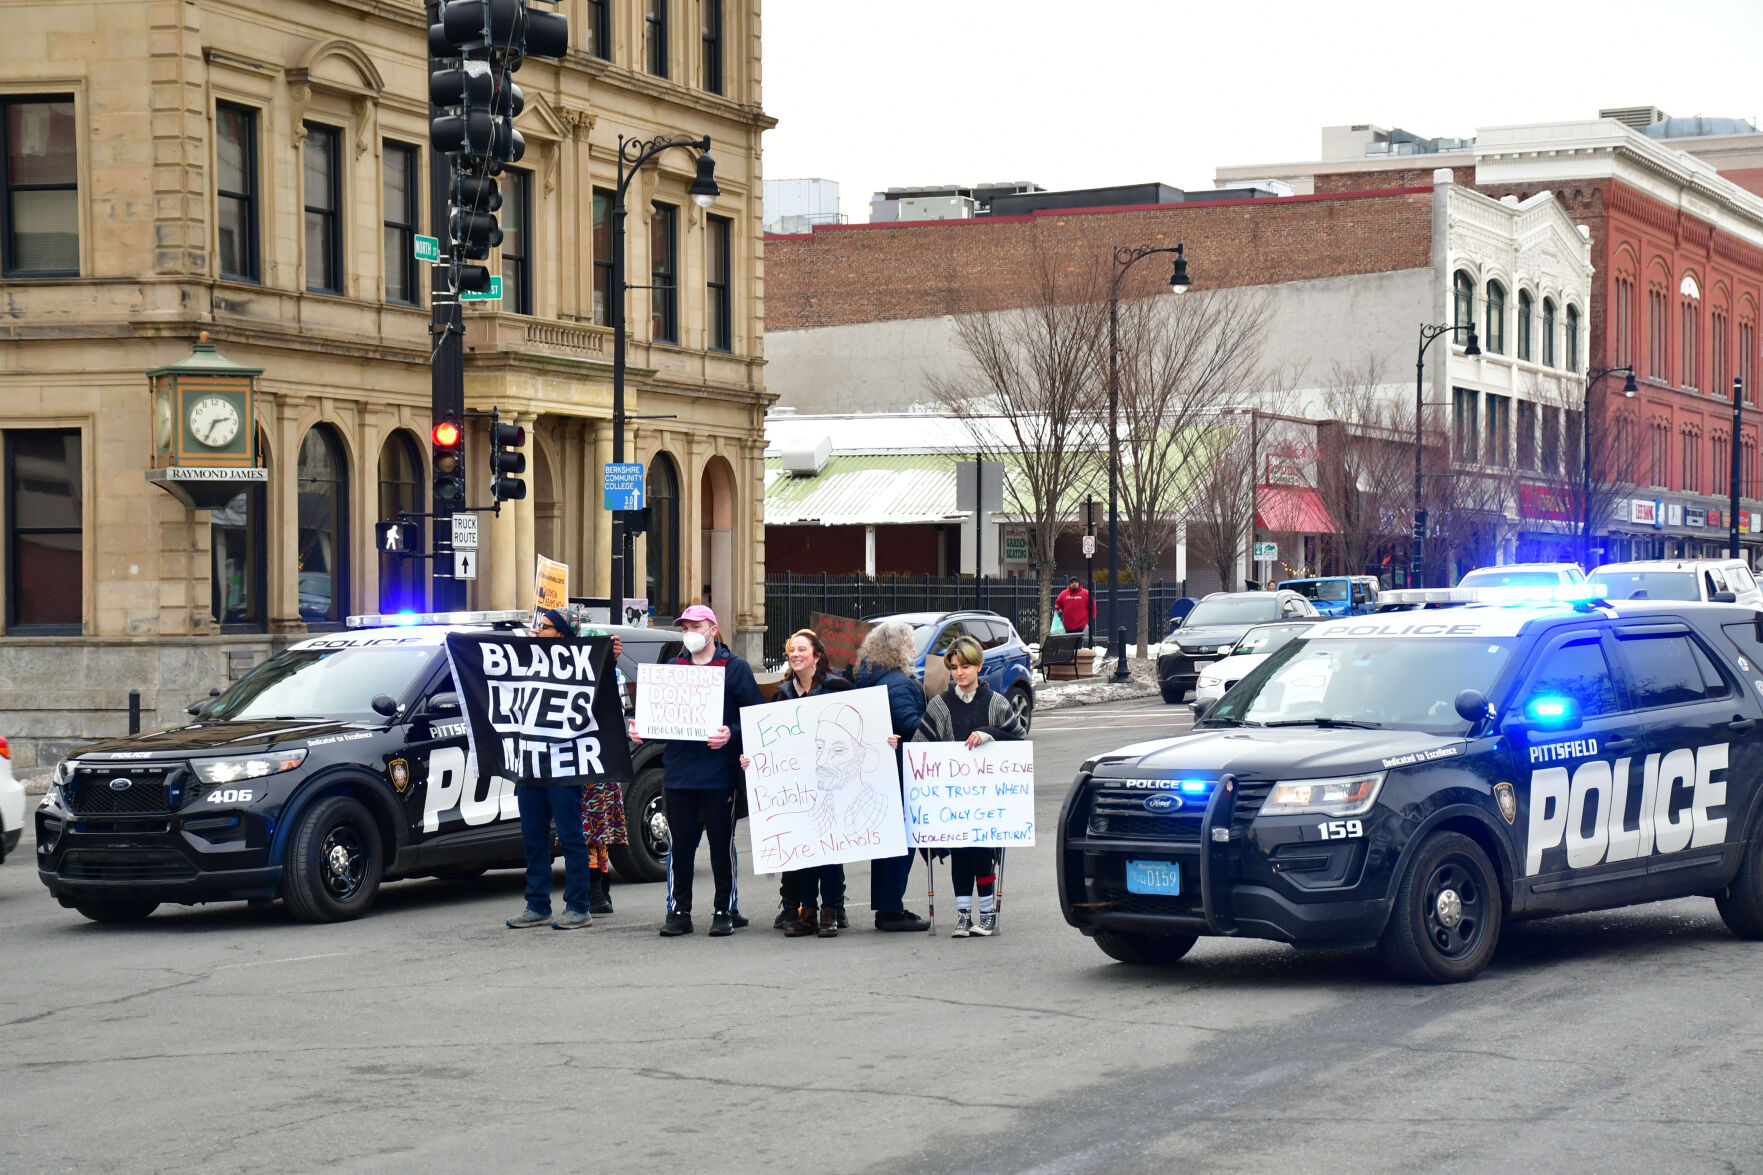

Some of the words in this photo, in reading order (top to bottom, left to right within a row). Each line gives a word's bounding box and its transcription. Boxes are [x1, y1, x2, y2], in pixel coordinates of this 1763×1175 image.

[416, 240, 432, 256] NORTH
[173, 470, 227, 479] RAYMOND
[229, 470, 263, 479] JAMES
[454, 518, 476, 529] TRUCK
[455, 533, 476, 543] ROUTE
[1322, 624, 1482, 636] POLICE
[307, 638, 423, 648] POLICE
[479, 642, 595, 681] BLACK
[638, 664, 724, 686] REFORMS
[650, 684, 711, 705] DON'T
[492, 685, 590, 731] LIVES
[650, 702, 706, 724] WORK
[757, 705, 805, 747] End
[307, 737, 336, 746] Dedicated
[1529, 738, 1598, 763] PITTSFIELD
[752, 750, 801, 780] Police
[908, 749, 941, 780] WHY
[949, 759, 970, 778] DO
[975, 758, 994, 775] WE
[1000, 760, 1033, 773] GIVE
[1382, 754, 1416, 768] Dedicated
[1424, 747, 1457, 759] Excellence
[910, 785, 940, 800] OUR
[945, 785, 988, 798] TRUST
[995, 782, 1029, 796] WHEN
[1126, 780, 1180, 789] POLICE
[207, 790, 253, 803] 406
[752, 782, 817, 812] Brutality
[910, 805, 930, 824] WE
[940, 807, 970, 822] ONLY
[974, 808, 1007, 820] GET
[1526, 742, 1729, 876] POLICE
[912, 832, 968, 844] VIOLENCE
[972, 828, 988, 842] IN
[991, 822, 1033, 840] RETURN?
[1318, 820, 1363, 840] 159
[760, 831, 815, 868] #Tyre
[820, 828, 881, 854] Nichols
